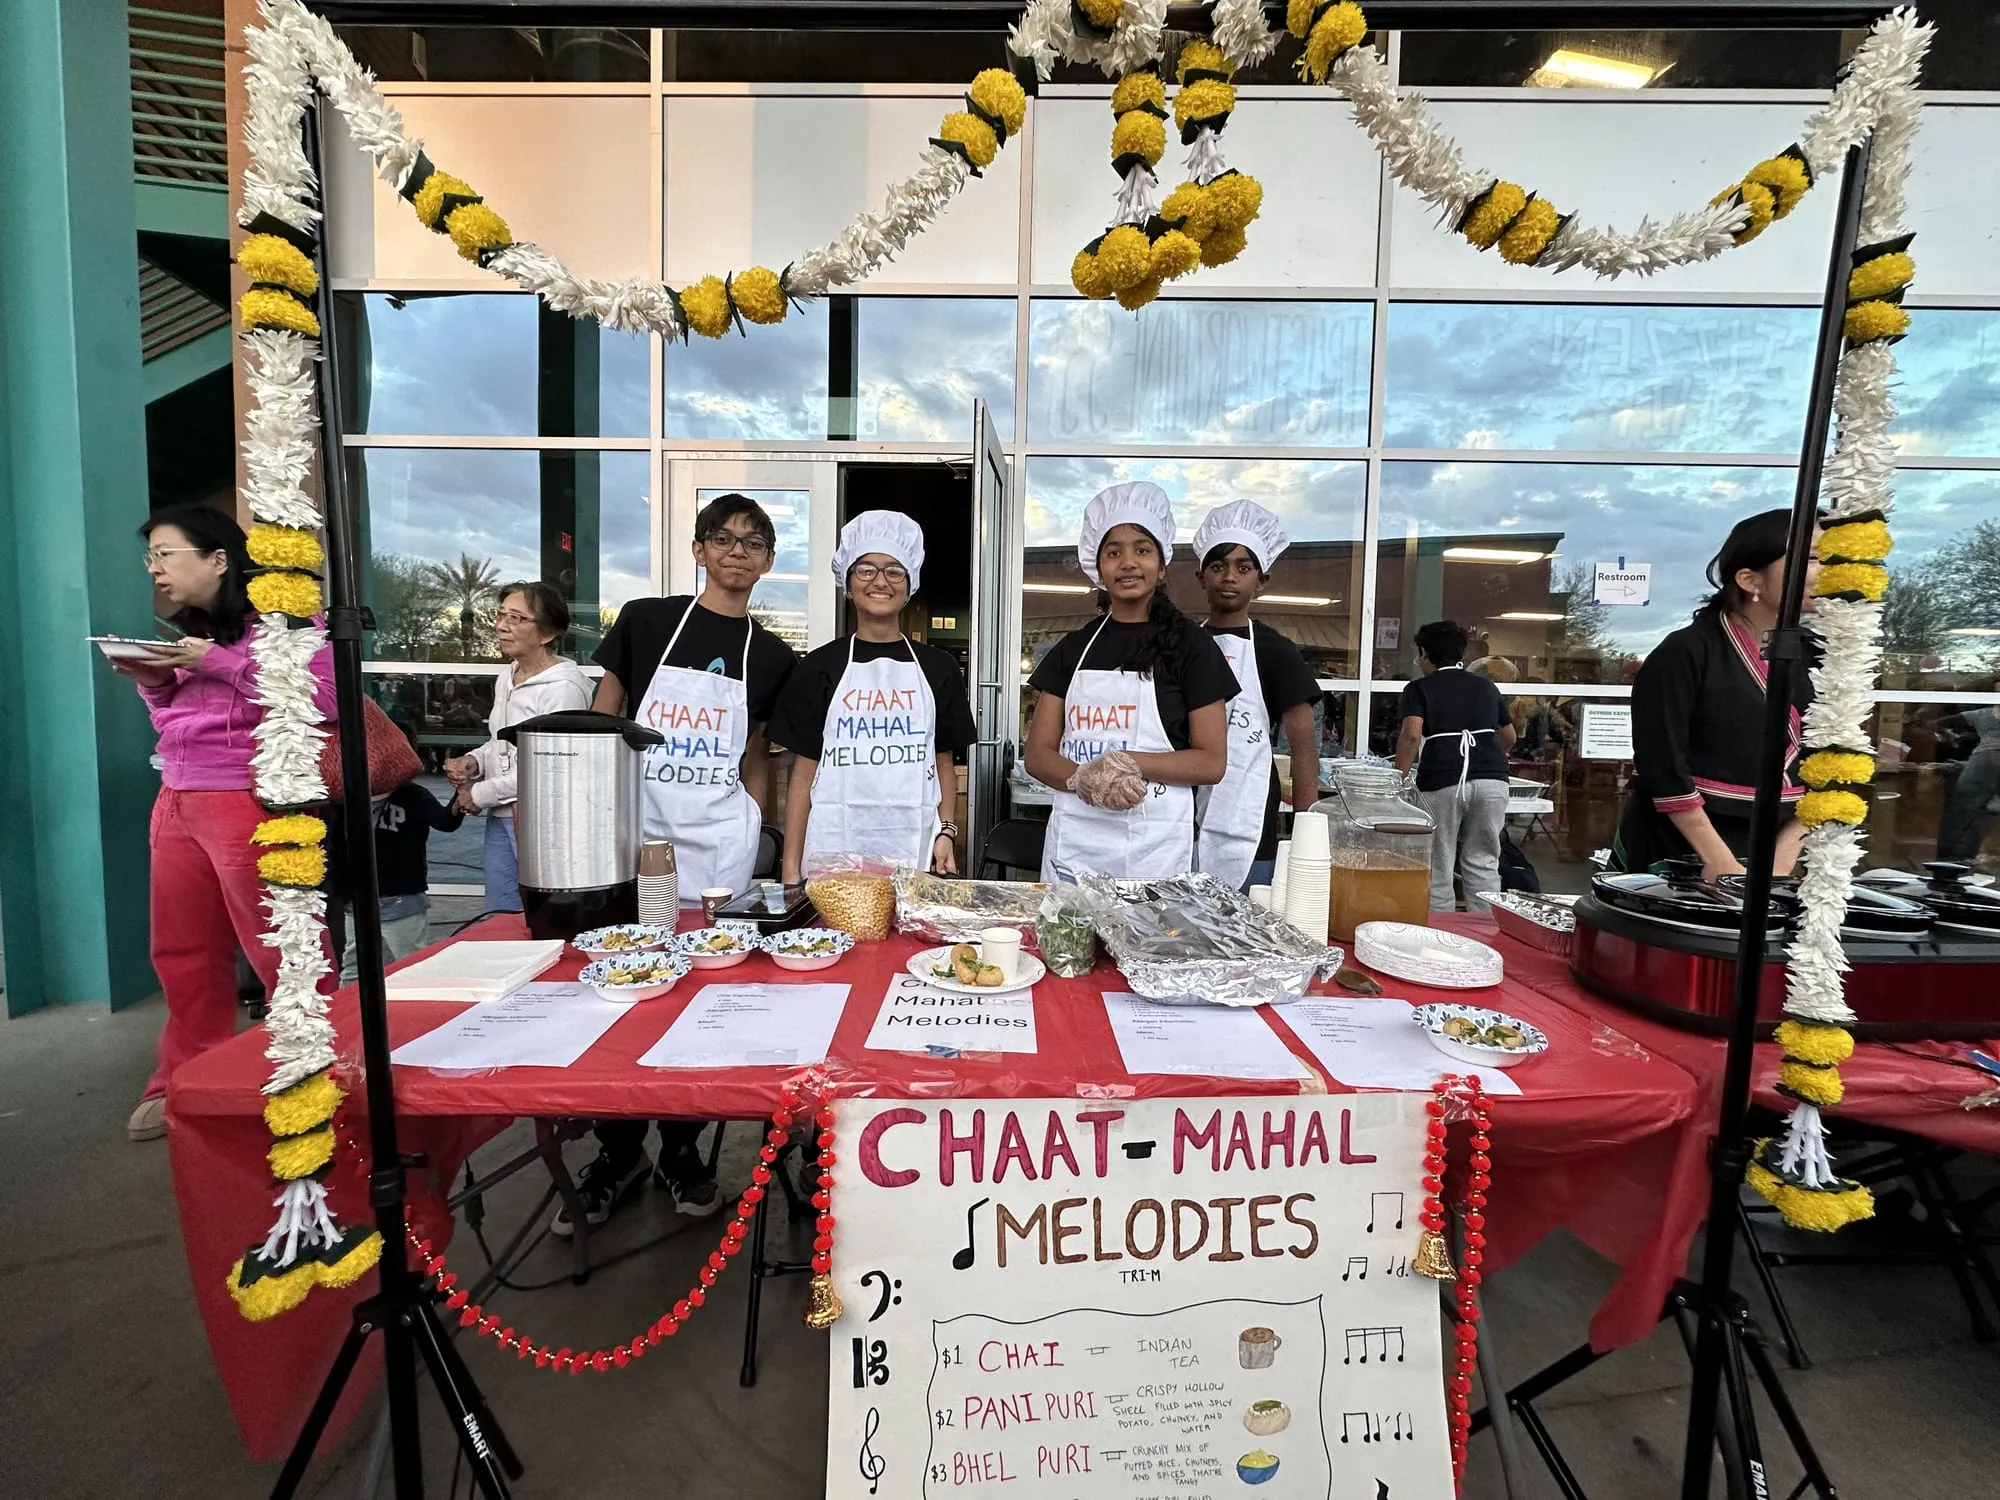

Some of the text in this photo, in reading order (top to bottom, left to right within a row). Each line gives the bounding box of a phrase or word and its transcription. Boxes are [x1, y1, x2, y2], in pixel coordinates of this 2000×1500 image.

[1598, 572, 1646, 581] Restroom
[842, 689, 916, 711] CHAAT
[647, 700, 727, 731] CHAAT
[836, 715, 926, 739] MAHAL
[1068, 705, 1136, 731] CHAAT
[1068, 739, 1127, 762] MAH
[644, 760, 738, 786] LODIES
[894, 995, 984, 1006] Mahal
[887, 1014, 1028, 1028] Melodies
[859, 1107, 1377, 1187] CHAAT MAHAL
[996, 1192, 1319, 1268] MELODIES
[1118, 1269, 1161, 1284] TRI-M
[942, 1338, 1192, 1372] $1 CHAI INDIAN
[1169, 1354, 1200, 1369] TEA
[935, 1382, 1224, 1431] $2 PANI PURI CRISPY HOLLOW
[1112, 1398, 1233, 1416] SHELL FILLED WITH SPICY
[1204, 1412, 1223, 1422] AND
[463, 1413, 490, 1459] EMART
[1181, 1423, 1211, 1434] WATER
[931, 1442, 1210, 1486] $3 BHEL PURI CRUNCHY MIX OF
[1132, 1473, 1150, 1481] AND
[1156, 1469, 1186, 1479] SPICES
[1749, 1459, 1769, 1500] EMA
